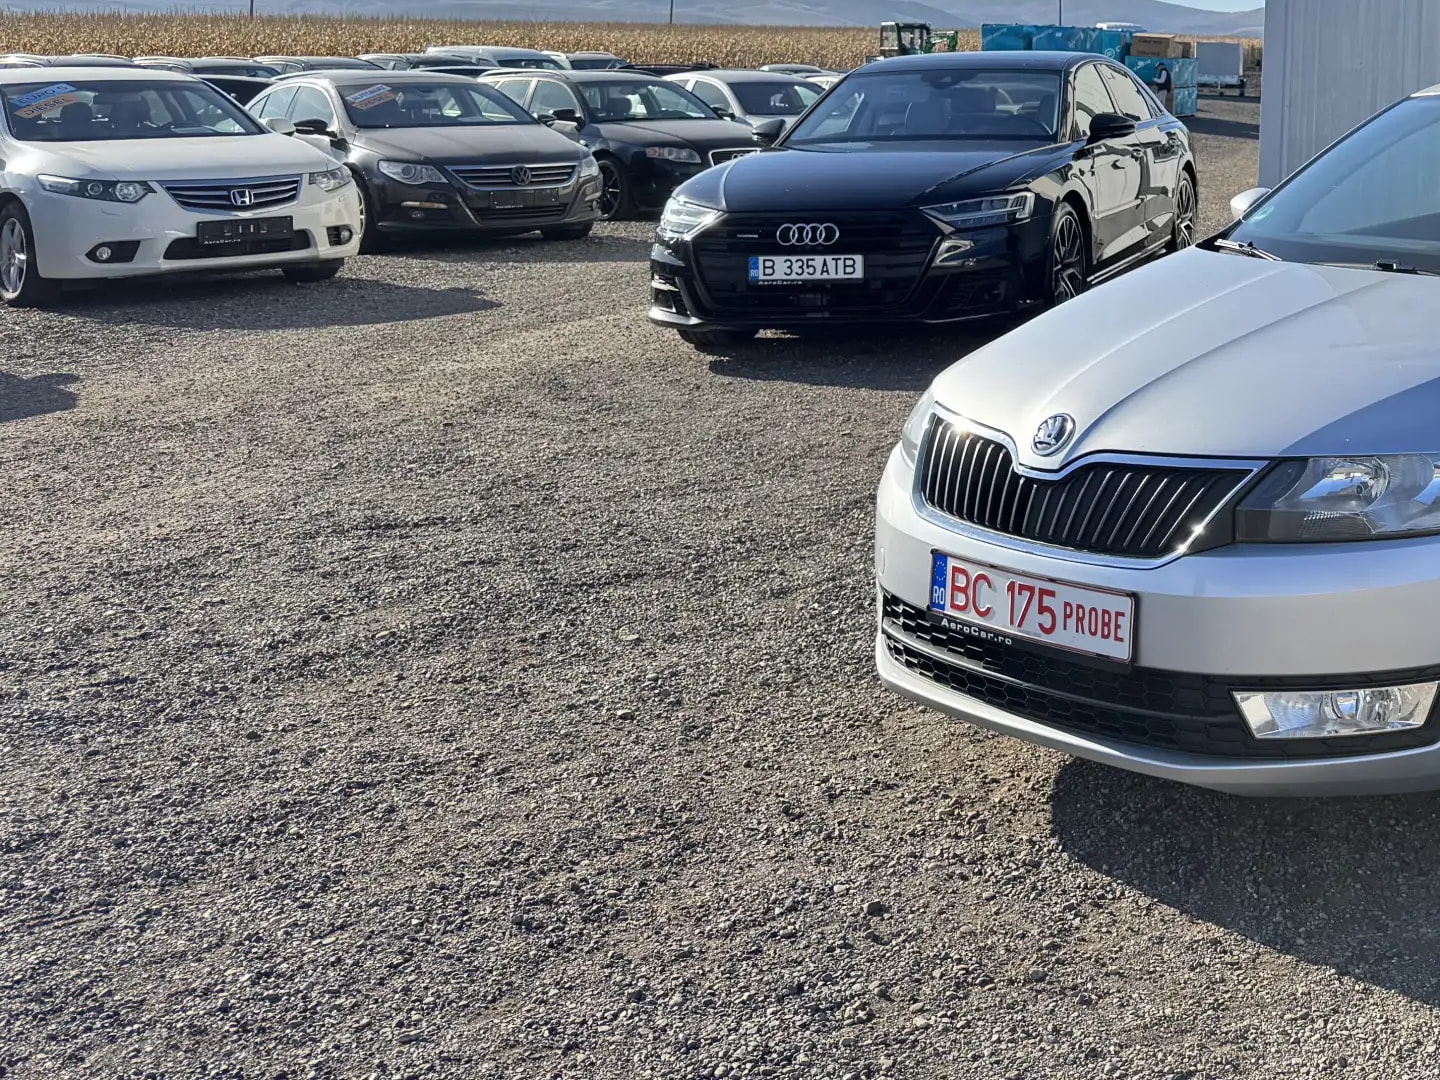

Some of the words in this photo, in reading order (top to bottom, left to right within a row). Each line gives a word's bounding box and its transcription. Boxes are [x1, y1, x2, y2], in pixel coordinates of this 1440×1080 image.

[25, 98, 69, 115] DIESEL
[750, 269, 759, 277] RO
[762, 258, 776, 276] B
[783, 258, 816, 276] 335
[820, 257, 857, 276] ATB
[932, 585, 945, 605] RO
[949, 564, 993, 617] BC
[1006, 579, 1057, 635] 175
[1063, 601, 1126, 643] PROBE
[940, 617, 1013, 646] AeroCar.ro
